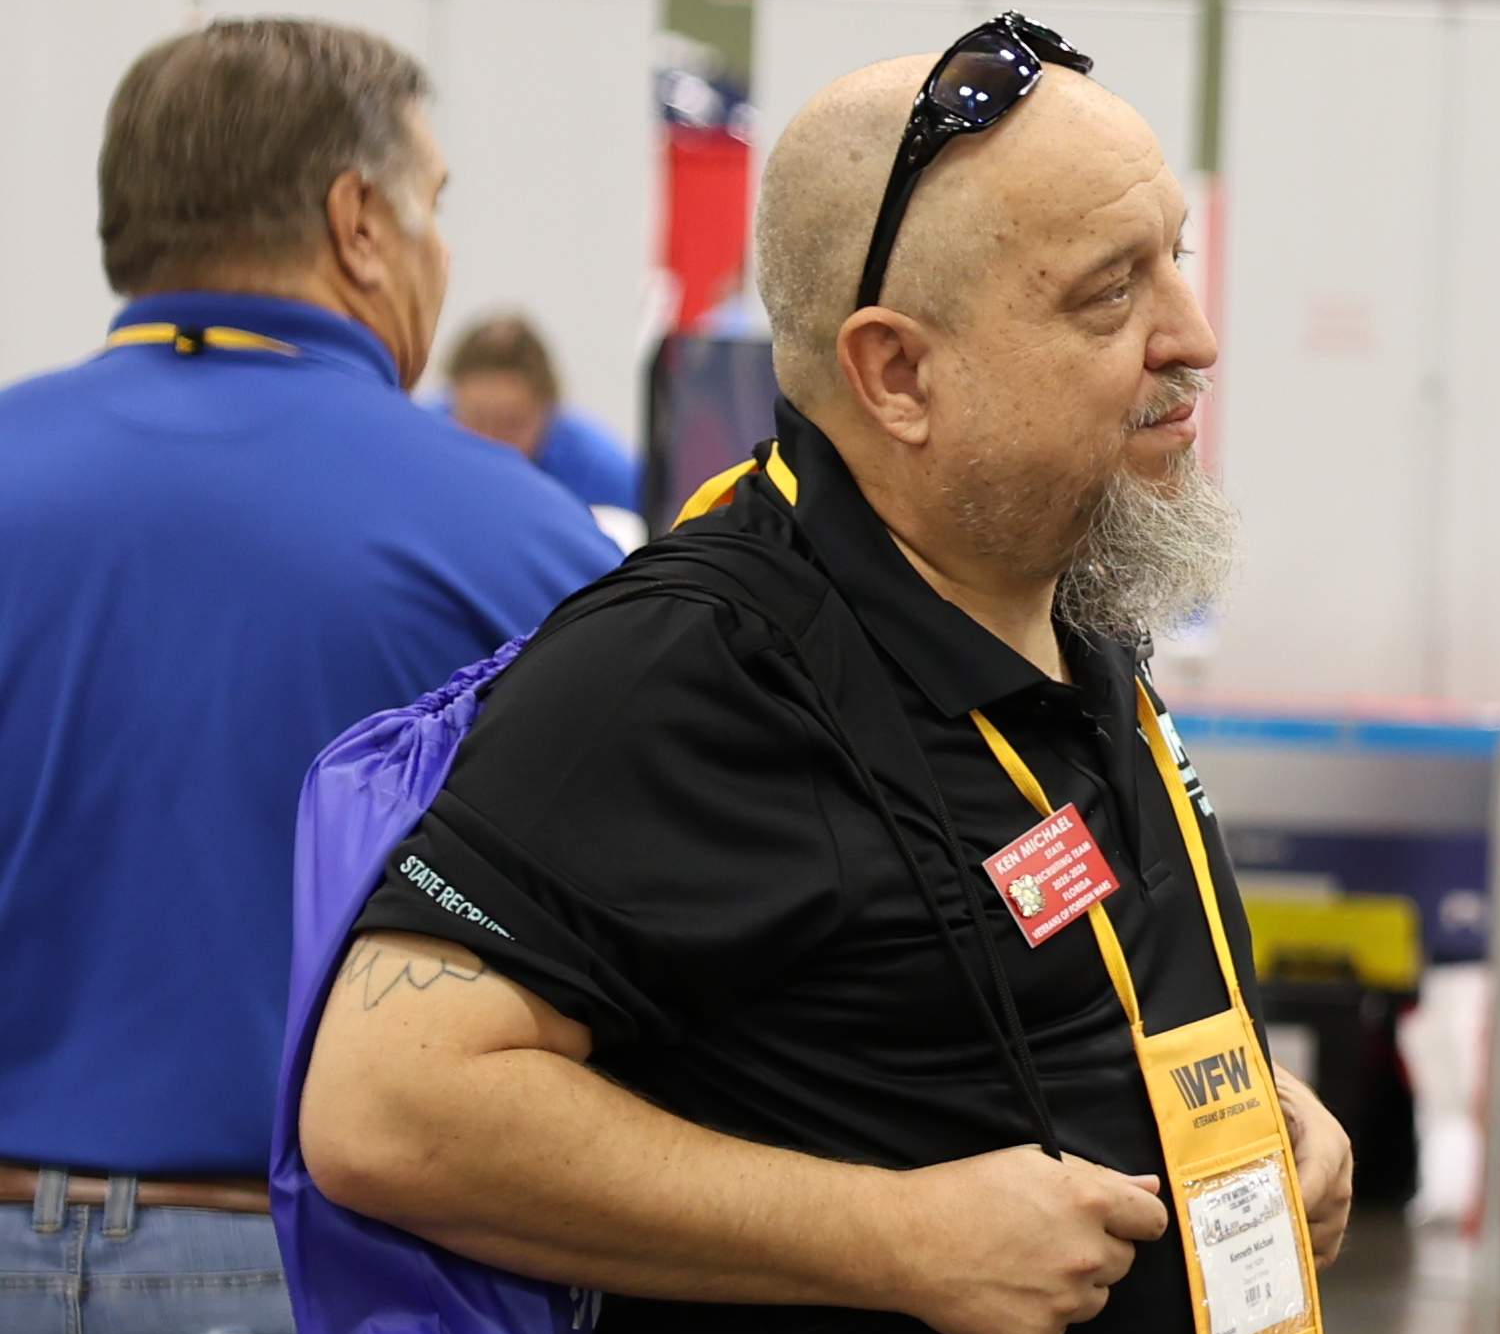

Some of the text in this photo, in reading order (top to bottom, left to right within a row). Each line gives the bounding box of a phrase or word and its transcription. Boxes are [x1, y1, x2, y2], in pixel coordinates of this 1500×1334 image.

[994, 815, 1075, 876] KEN MICHAEL
[1043, 841, 1066, 860] STATE
[1070, 840, 1093, 861] TEAM
[400, 855, 445, 898] STATE
[1062, 877, 1093, 903] FLORIDA
[1170, 1046, 1251, 1111] VFW
